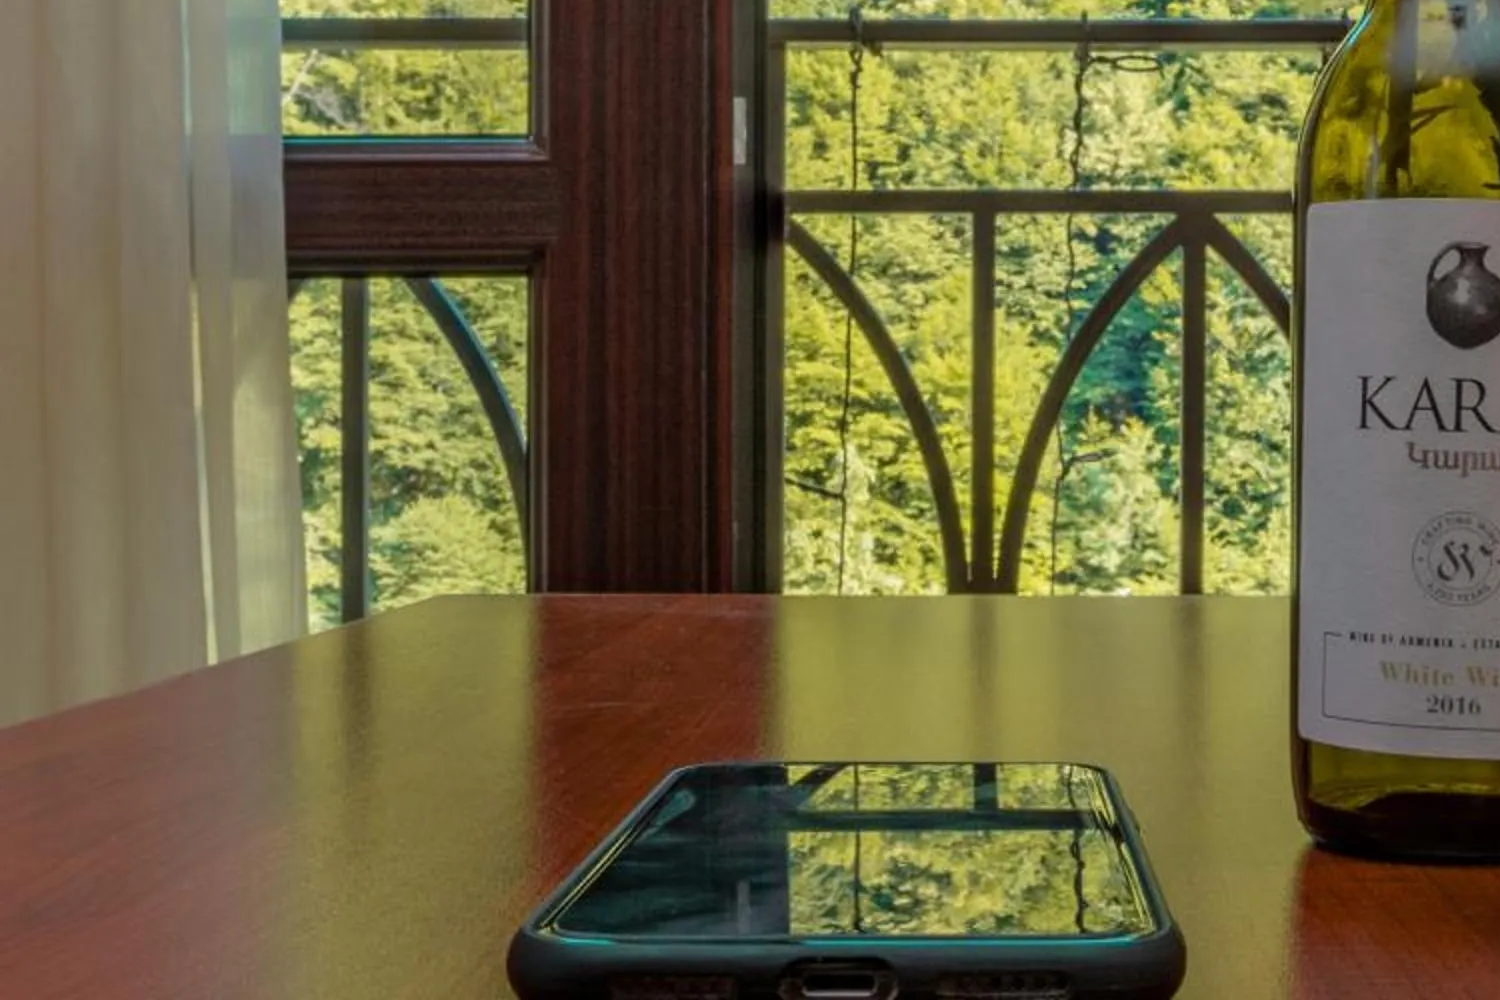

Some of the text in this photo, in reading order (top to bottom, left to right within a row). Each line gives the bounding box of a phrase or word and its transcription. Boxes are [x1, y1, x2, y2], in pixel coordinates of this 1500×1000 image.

[1349, 631, 1375, 643] WINE
[1381, 633, 1394, 645] OF
[1399, 635, 1454, 649] ARMENIA
[1379, 660, 1454, 686] White
[1426, 694, 1482, 716] 2016
